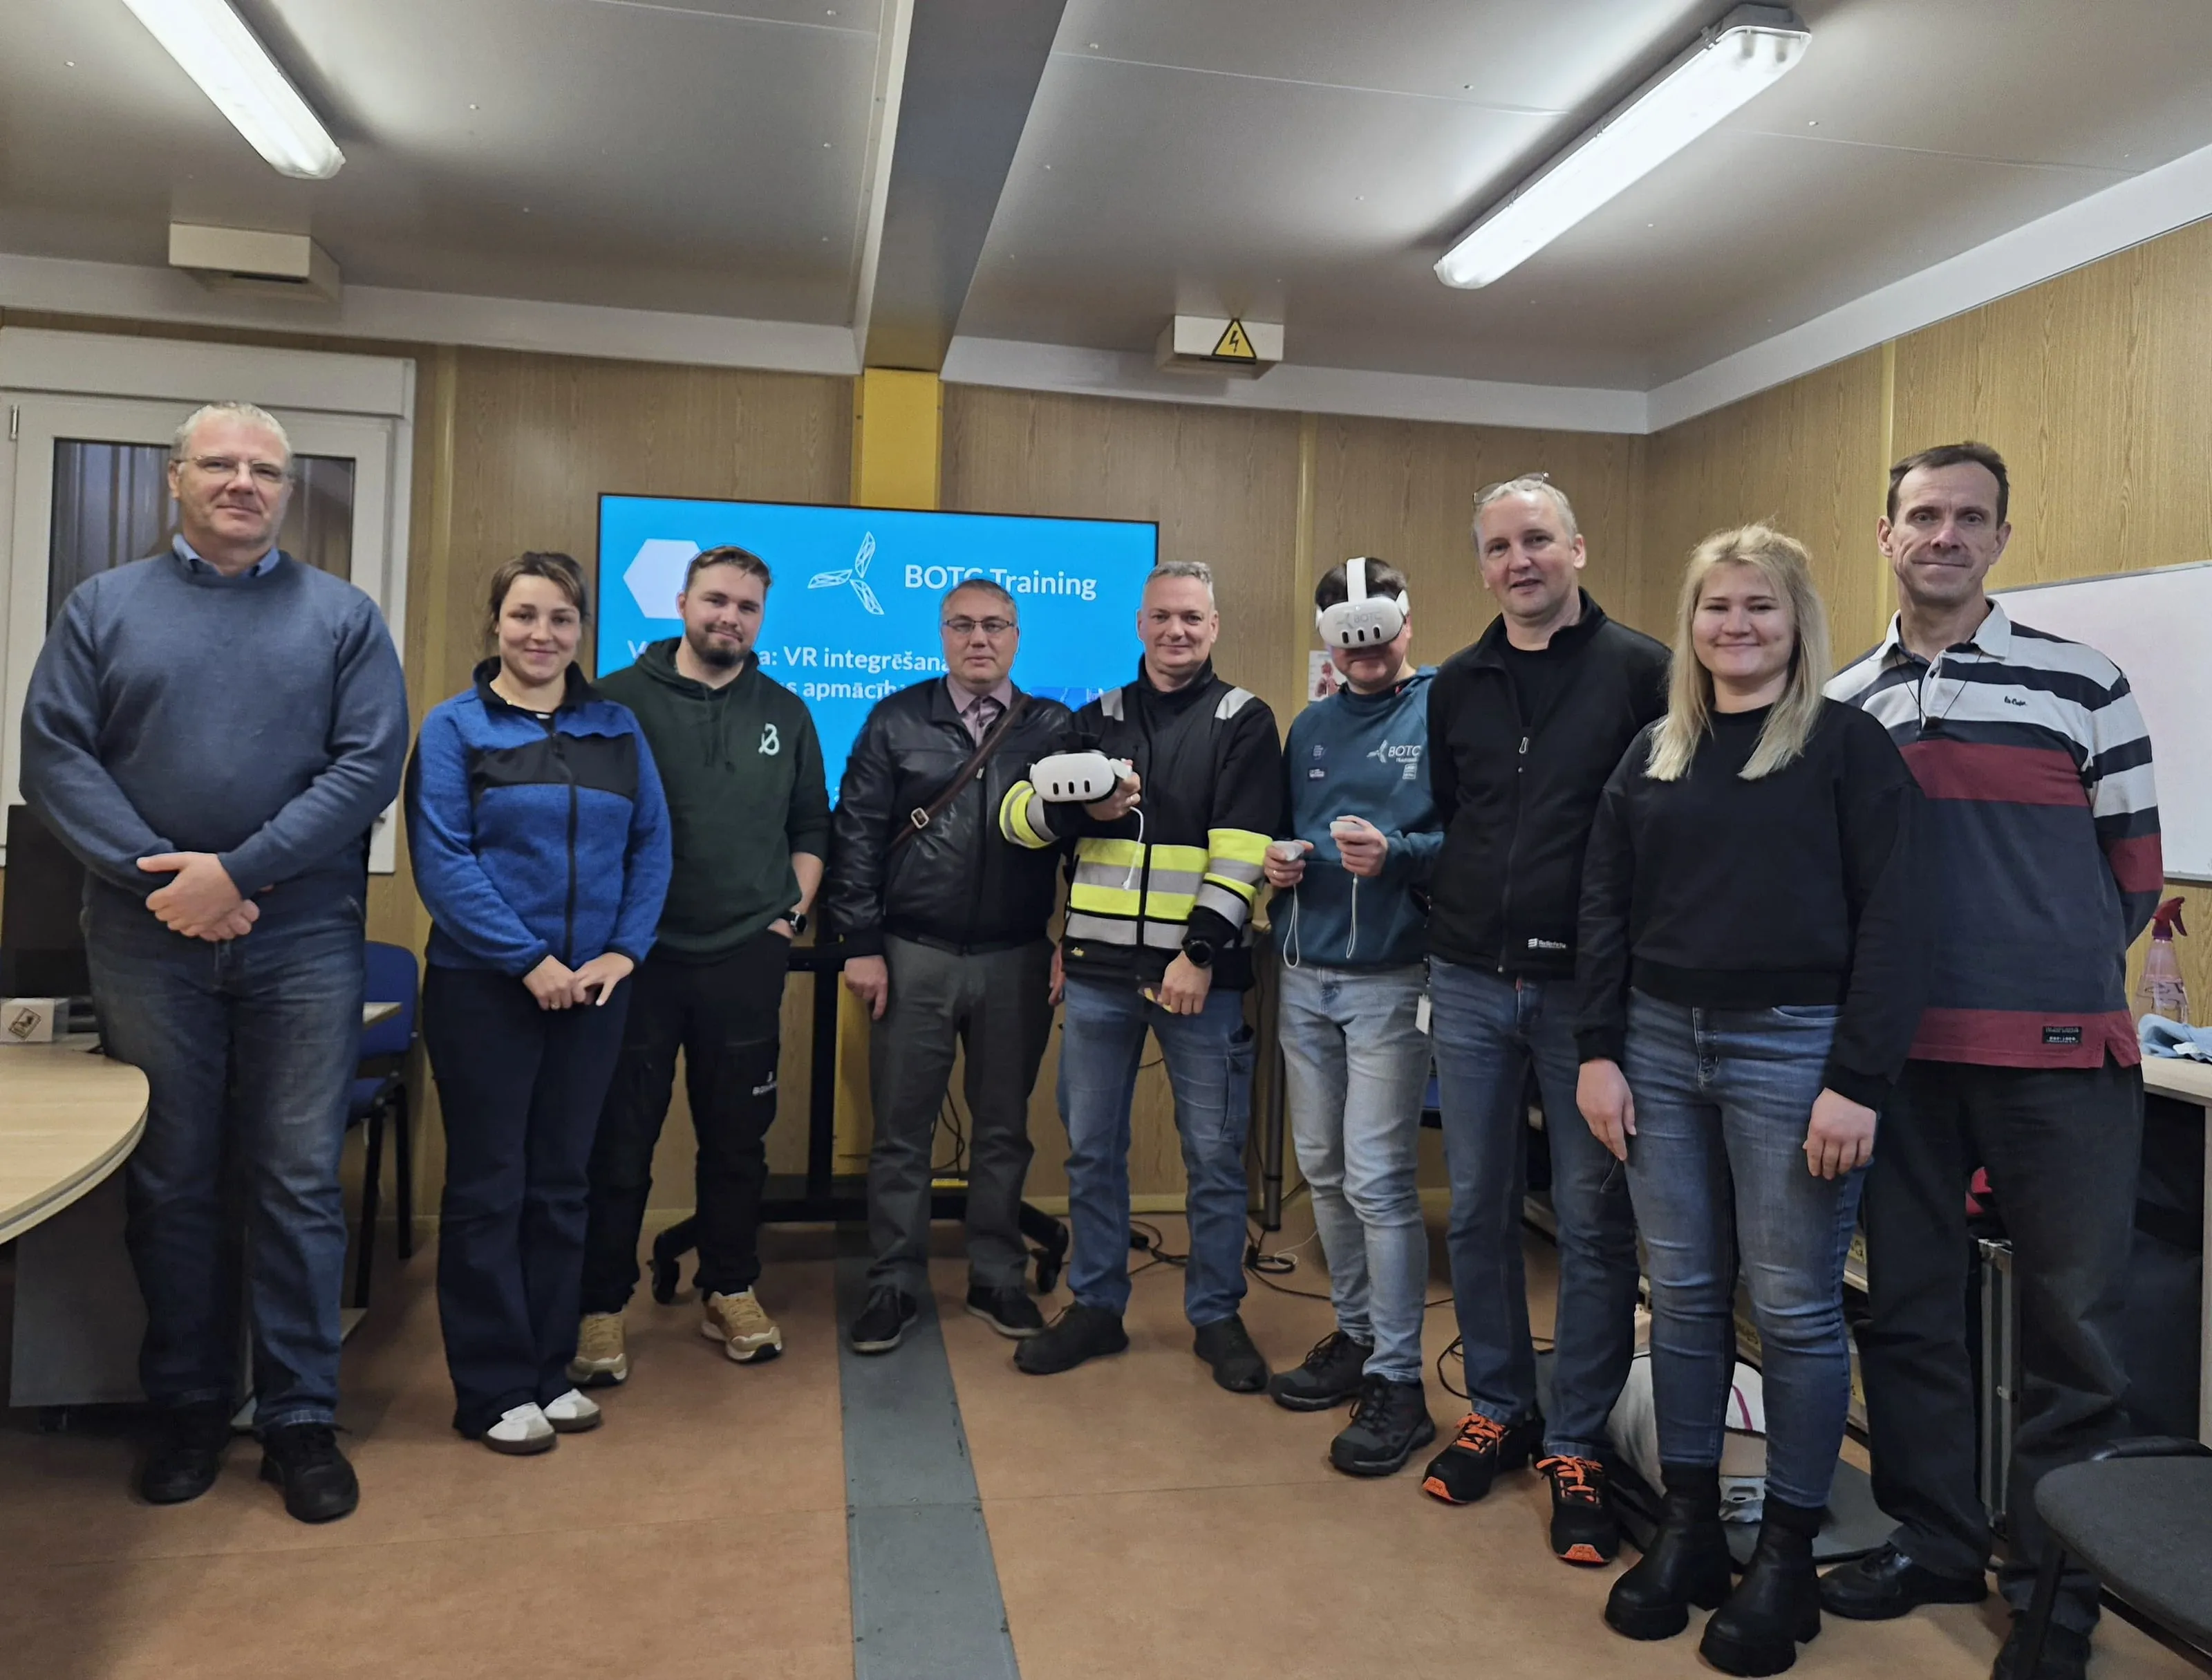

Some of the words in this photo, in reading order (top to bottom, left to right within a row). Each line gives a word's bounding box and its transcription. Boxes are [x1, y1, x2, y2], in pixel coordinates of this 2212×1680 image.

[989, 568, 1097, 601] Training
[783, 646, 818, 667] VR
[1388, 745, 1421, 758] BOTC
